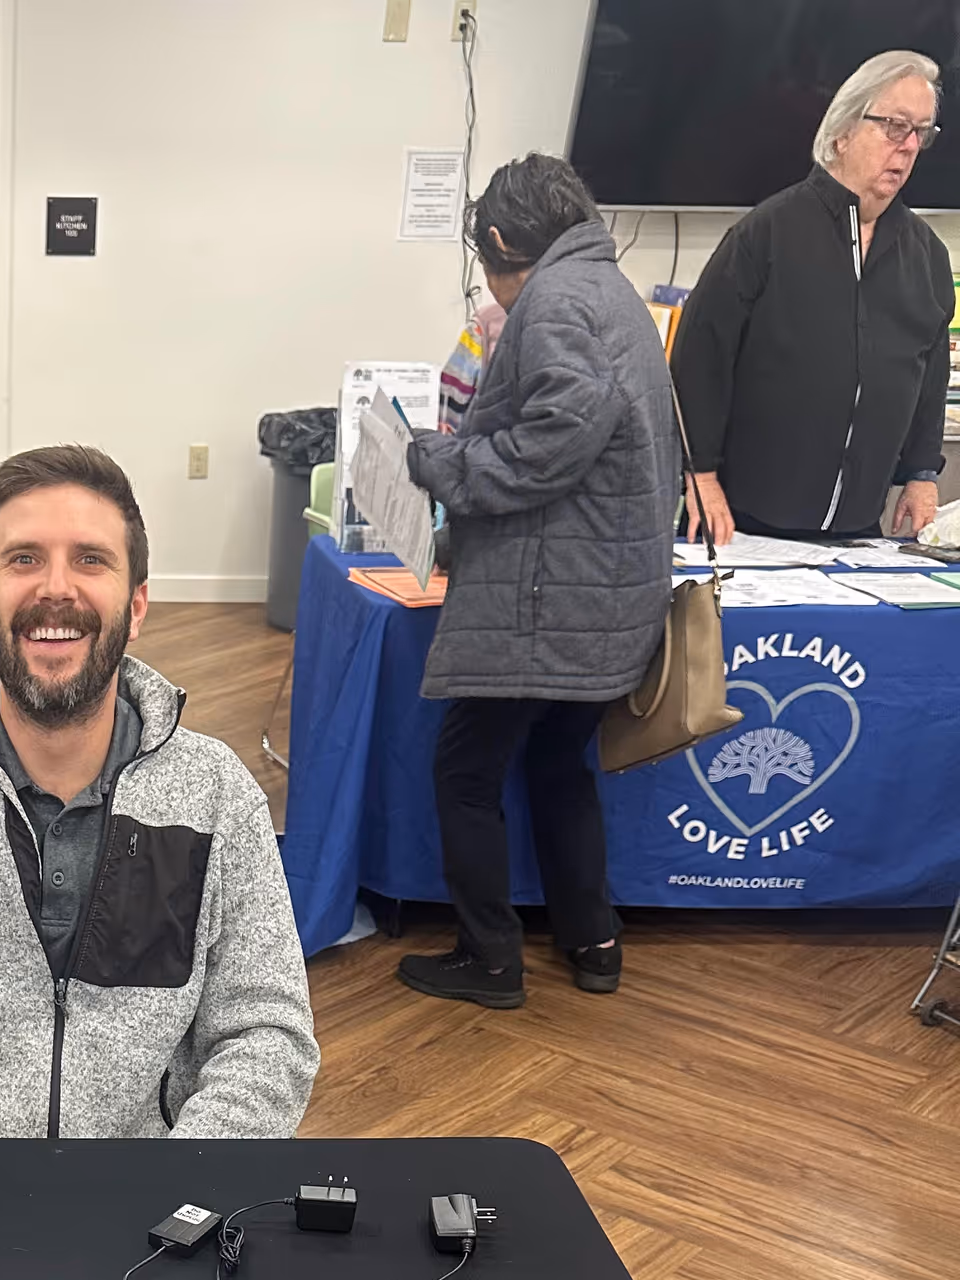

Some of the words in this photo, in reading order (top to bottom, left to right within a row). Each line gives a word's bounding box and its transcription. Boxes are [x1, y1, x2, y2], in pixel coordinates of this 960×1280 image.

[56, 222, 88, 230] KITCHEN
[723, 633, 867, 690] AKLAND
[667, 803, 749, 861] LOVE
[760, 807, 835, 858] LIFE
[668, 874, 806, 889] #OAKLANDLOVELIFE
